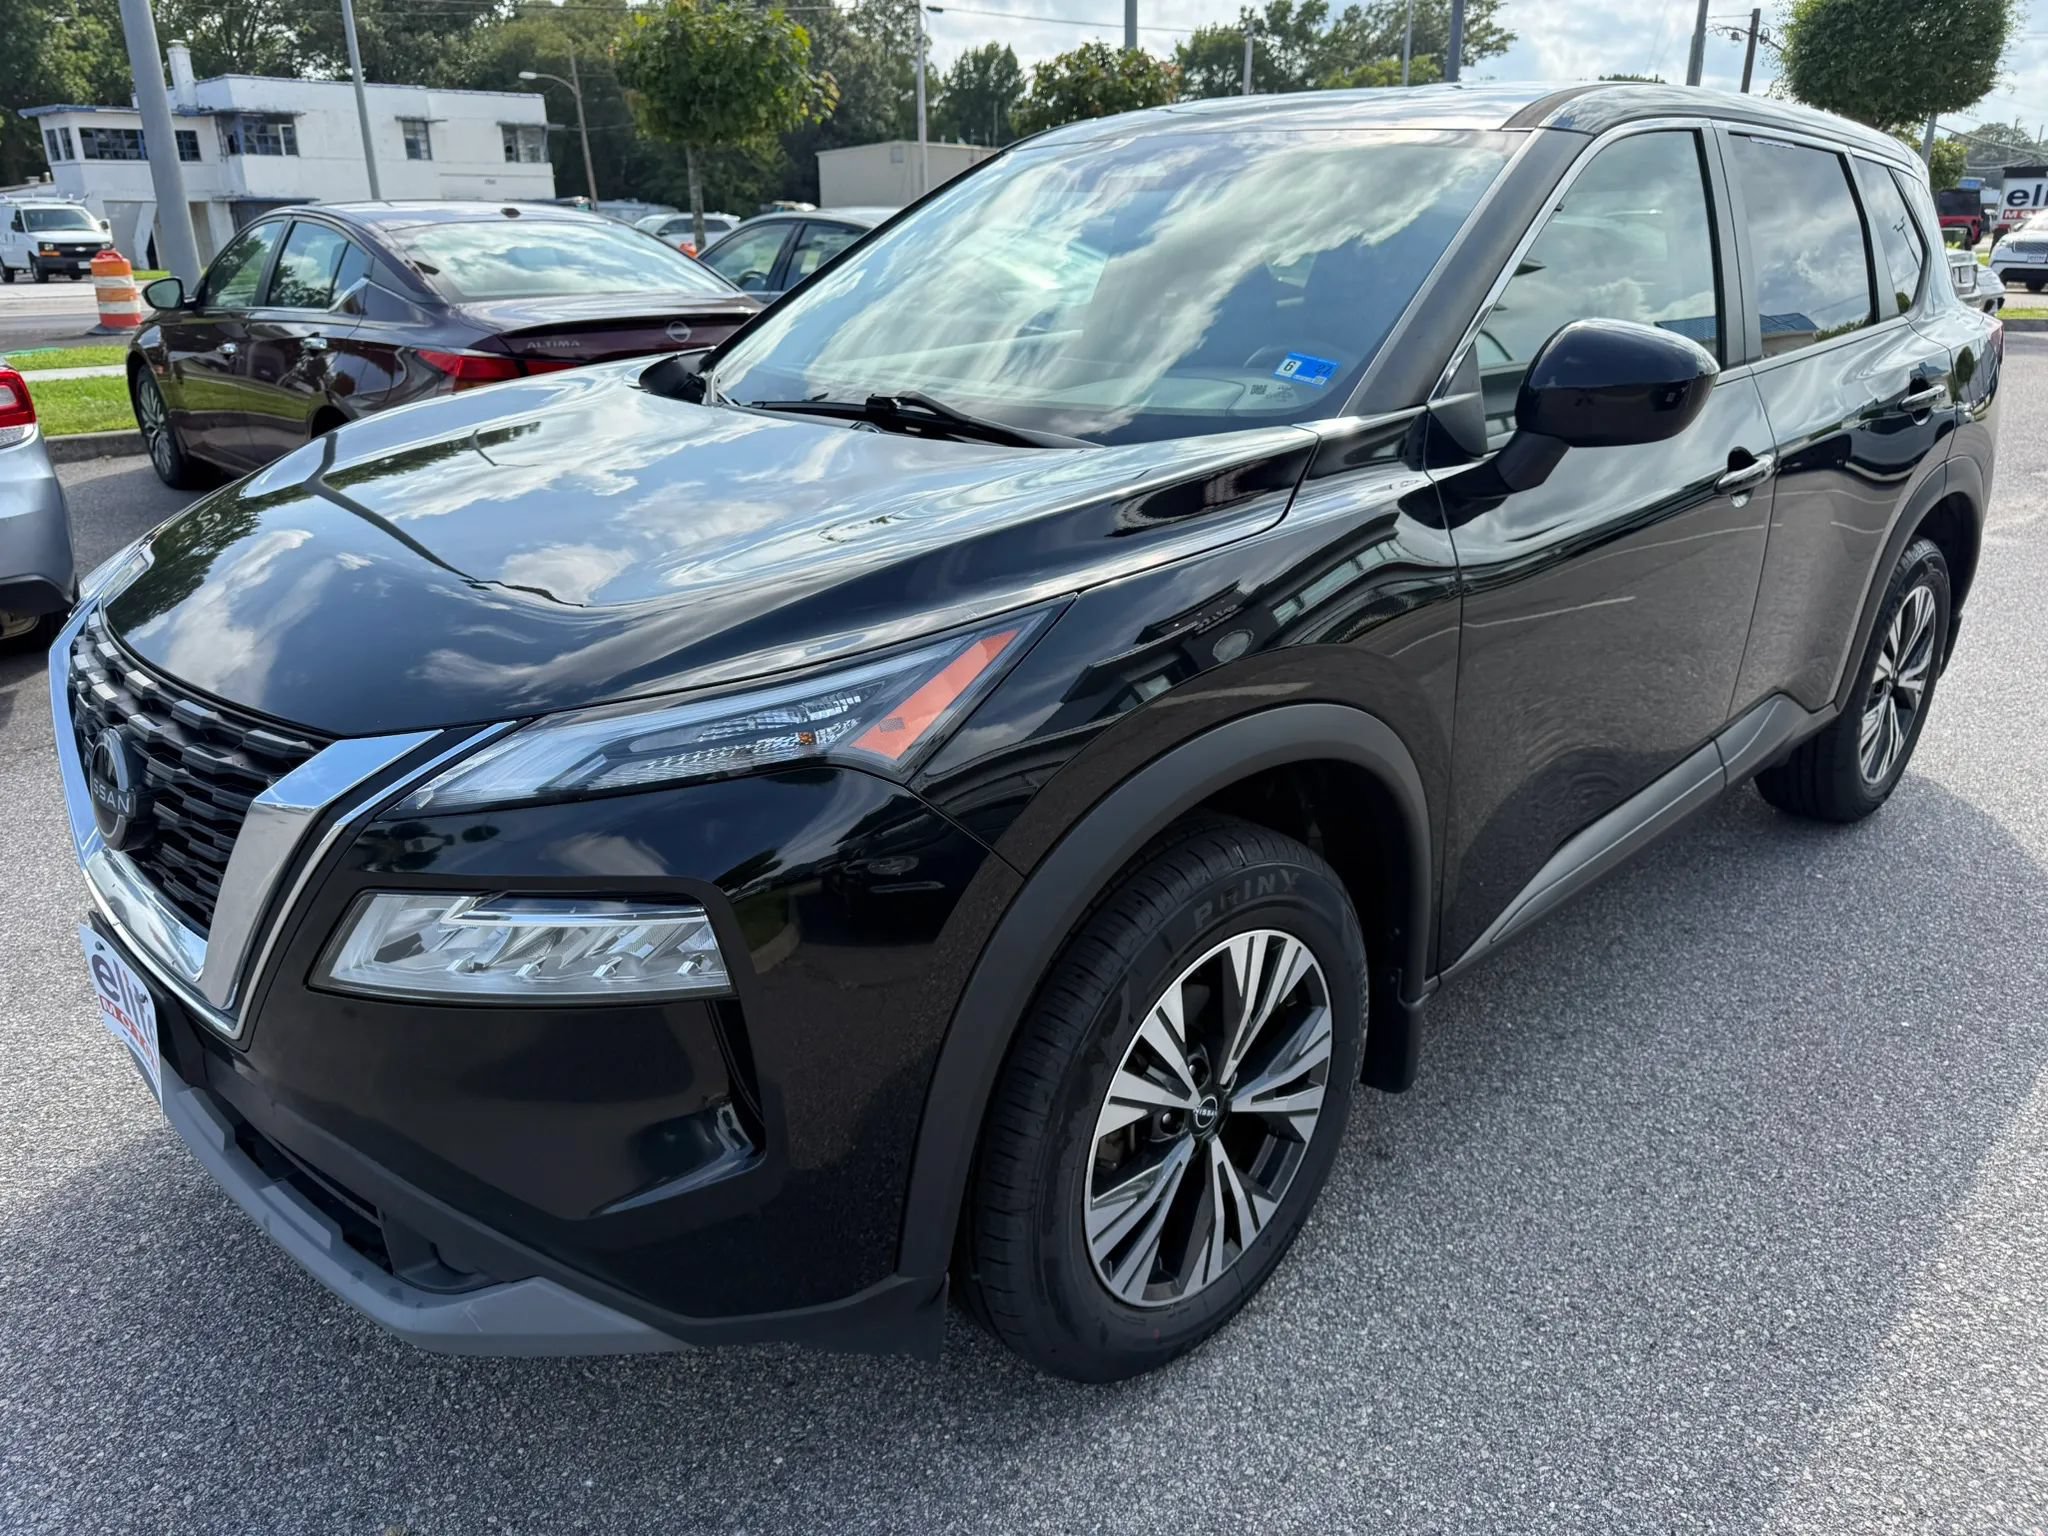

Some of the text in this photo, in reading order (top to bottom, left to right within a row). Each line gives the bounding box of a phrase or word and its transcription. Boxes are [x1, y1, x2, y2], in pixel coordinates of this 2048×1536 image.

[527, 340, 581, 350] ALTIMA
[1283, 361, 1296, 372] 6
[93, 778, 129, 814] SSAN
